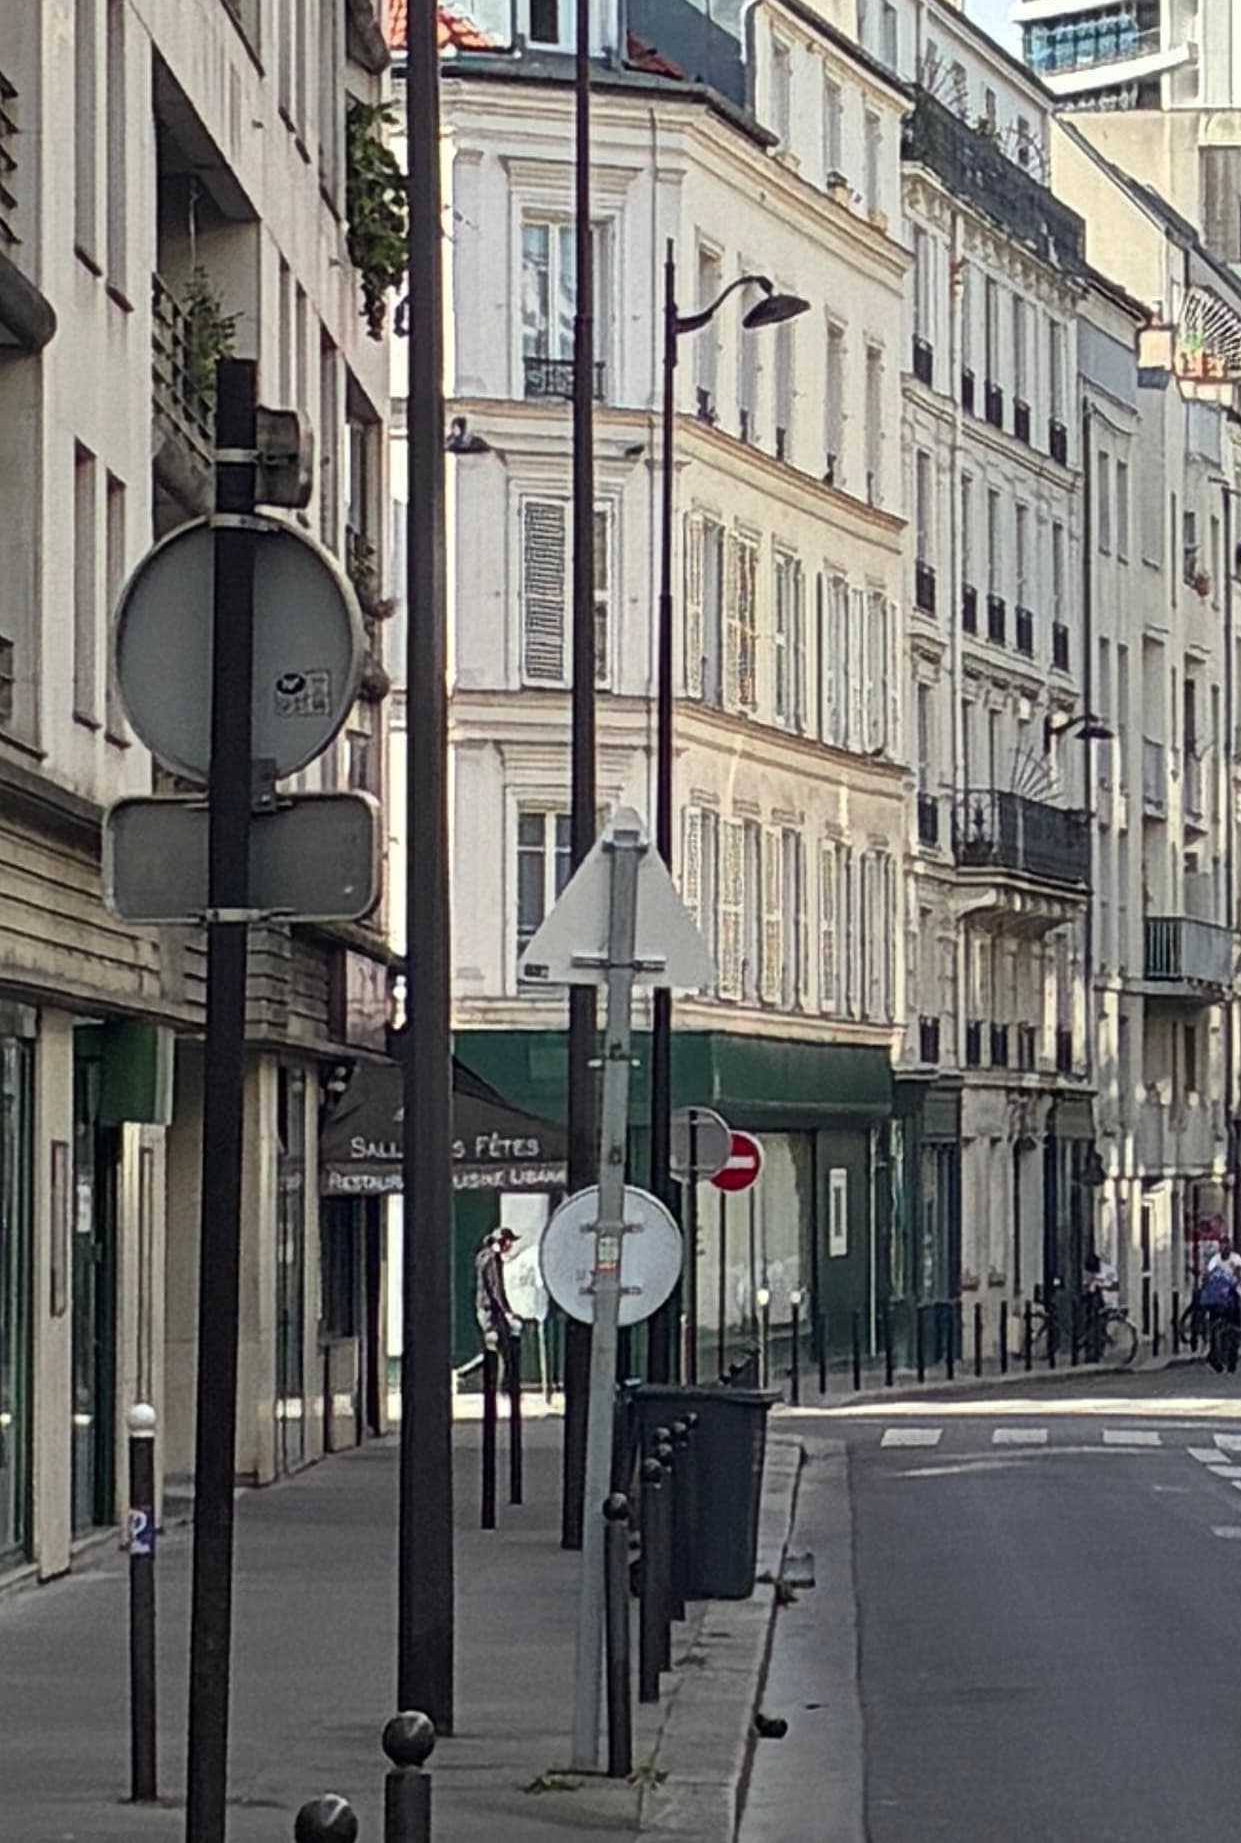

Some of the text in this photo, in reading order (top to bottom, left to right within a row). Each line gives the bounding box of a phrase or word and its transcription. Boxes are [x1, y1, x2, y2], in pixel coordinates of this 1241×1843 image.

[351, 1136, 404, 1158] SALL
[475, 1131, 540, 1157] FÊTES
[327, 1171, 404, 1190] RESTAUR
[452, 1171, 503, 1189] UISINE
